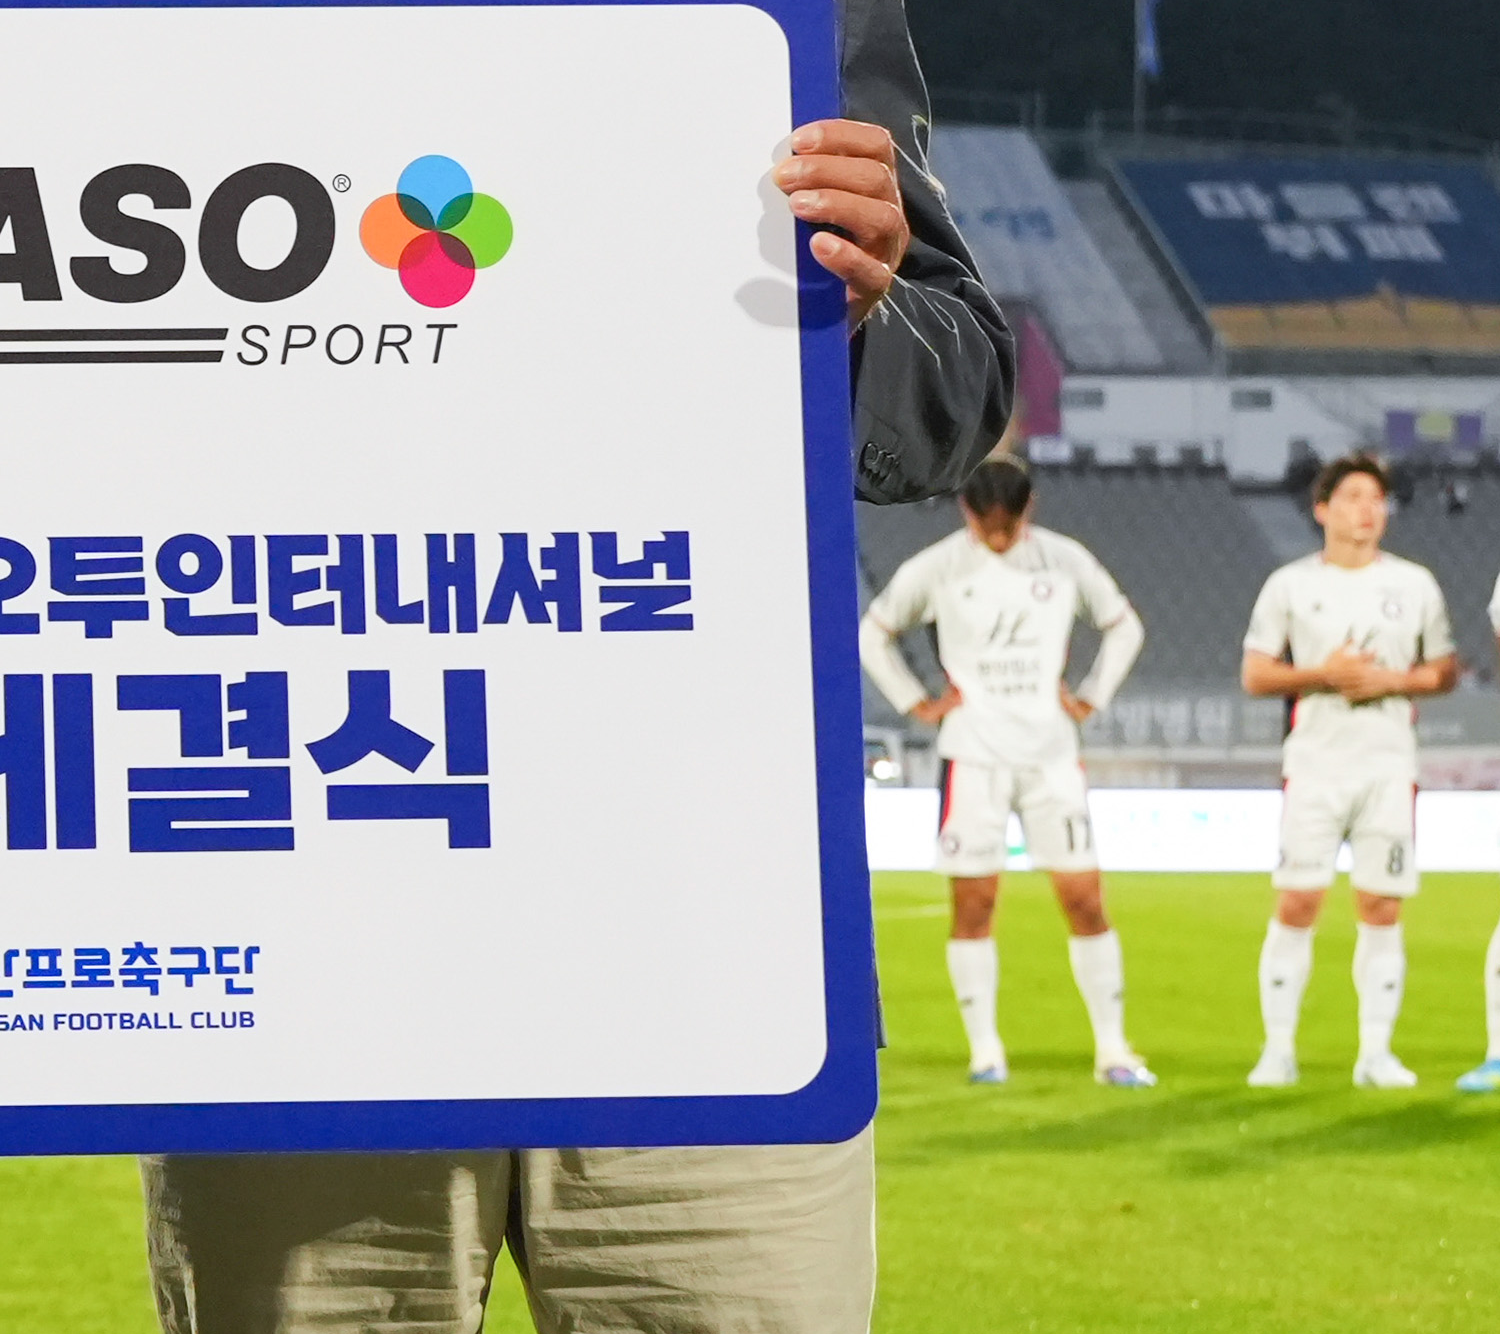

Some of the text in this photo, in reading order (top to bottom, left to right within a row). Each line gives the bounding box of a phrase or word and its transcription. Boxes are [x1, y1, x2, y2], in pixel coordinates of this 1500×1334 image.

[237, 324, 458, 366] SPORT
[53, 1012, 183, 1031] FOOTBALL
[190, 1011, 255, 1029] CLUB
